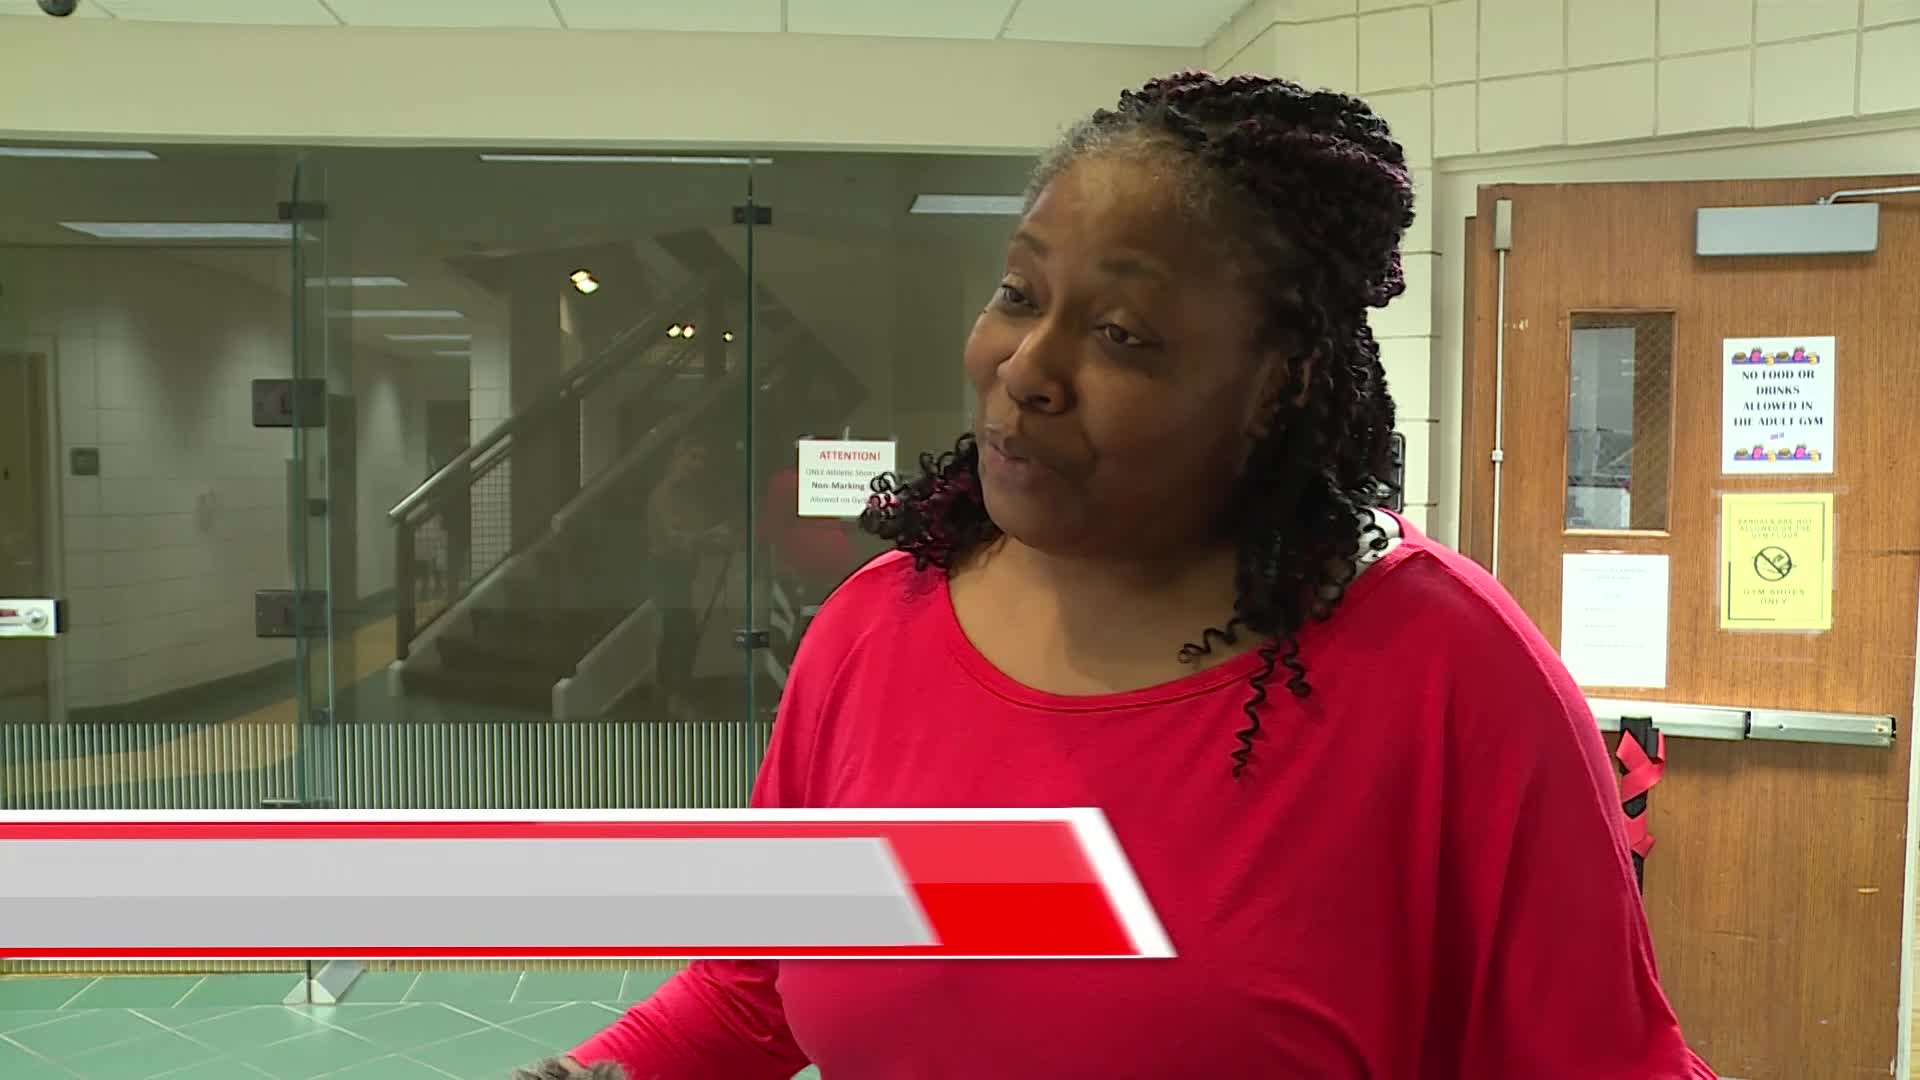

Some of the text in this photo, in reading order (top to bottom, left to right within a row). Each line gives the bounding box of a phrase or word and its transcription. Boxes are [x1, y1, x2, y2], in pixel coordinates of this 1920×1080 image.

[1742, 370, 1815, 379] NO FOOD OR
[1756, 386, 1800, 395] DRINKS
[1743, 401, 1813, 411] ALLOWED IN
[1733, 416, 1823, 427] THE ADULT GYM
[820, 451, 880, 461] ATTENTION!
